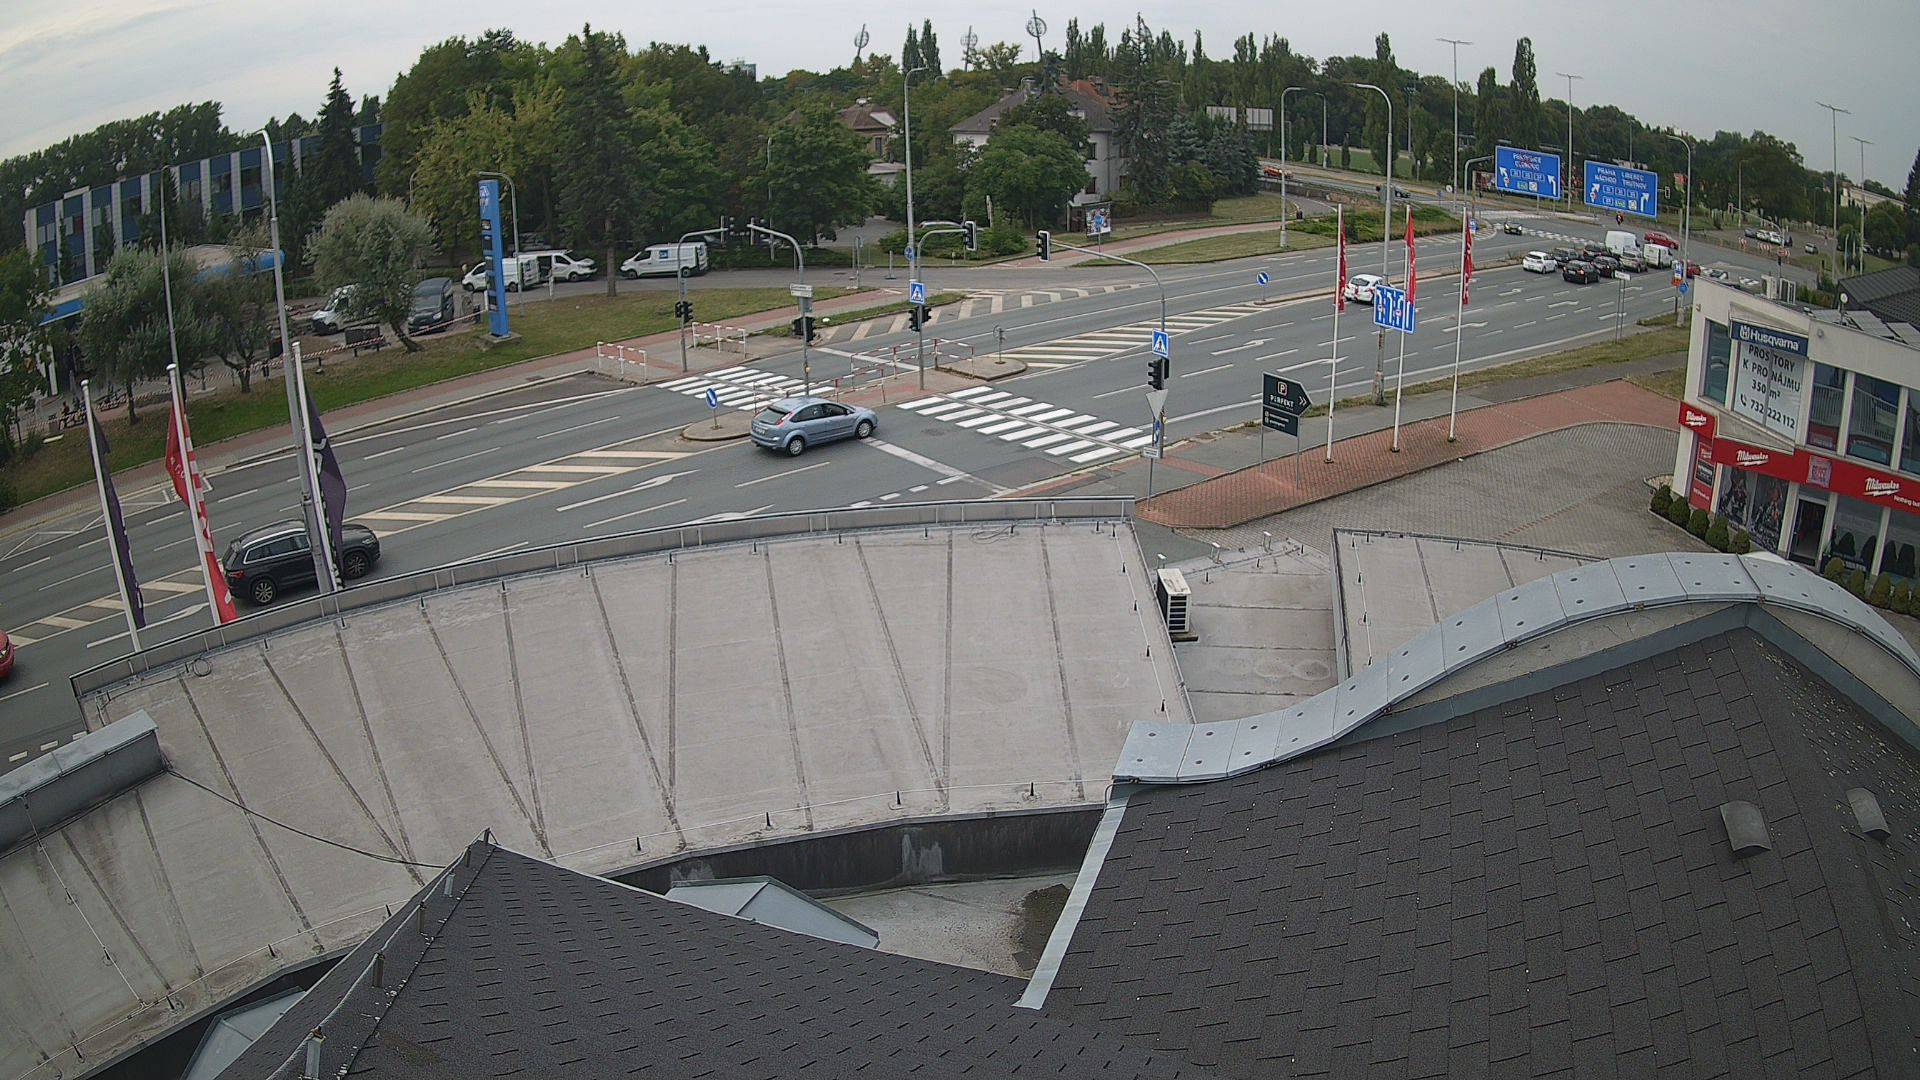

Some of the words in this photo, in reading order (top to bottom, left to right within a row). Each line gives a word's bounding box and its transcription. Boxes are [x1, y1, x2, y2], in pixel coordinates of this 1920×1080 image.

[1750, 327, 1799, 351] Husqvarna
[1743, 358, 1749, 370] K
[1751, 379, 1767, 394] 350
[1736, 449, 1769, 462] Milwaukee
[1865, 477, 1900, 491] Milwaukee
